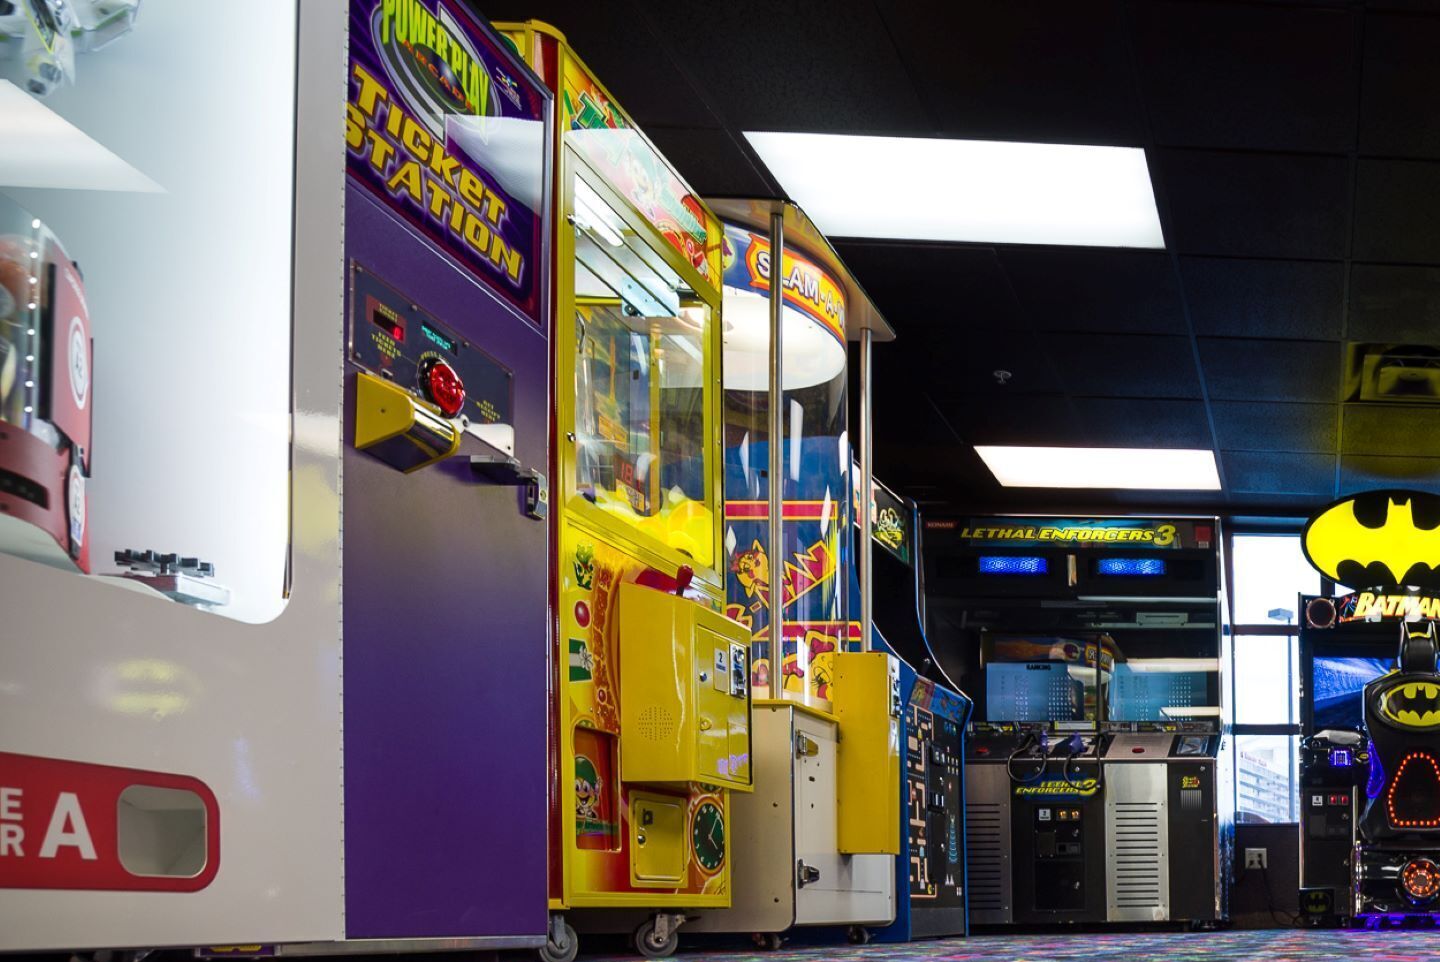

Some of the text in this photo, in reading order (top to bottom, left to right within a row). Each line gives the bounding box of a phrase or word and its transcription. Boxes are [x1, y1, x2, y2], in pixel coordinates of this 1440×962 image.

[403, 39, 474, 113] ARCADE
[353, 65, 506, 224] TICKET
[347, 103, 523, 280] STATION
[961, 524, 1176, 545] LETHAL ENFORCERS 3
[39, 791, 98, 860] A
[1016, 787, 1080, 795] ENFORCERS
